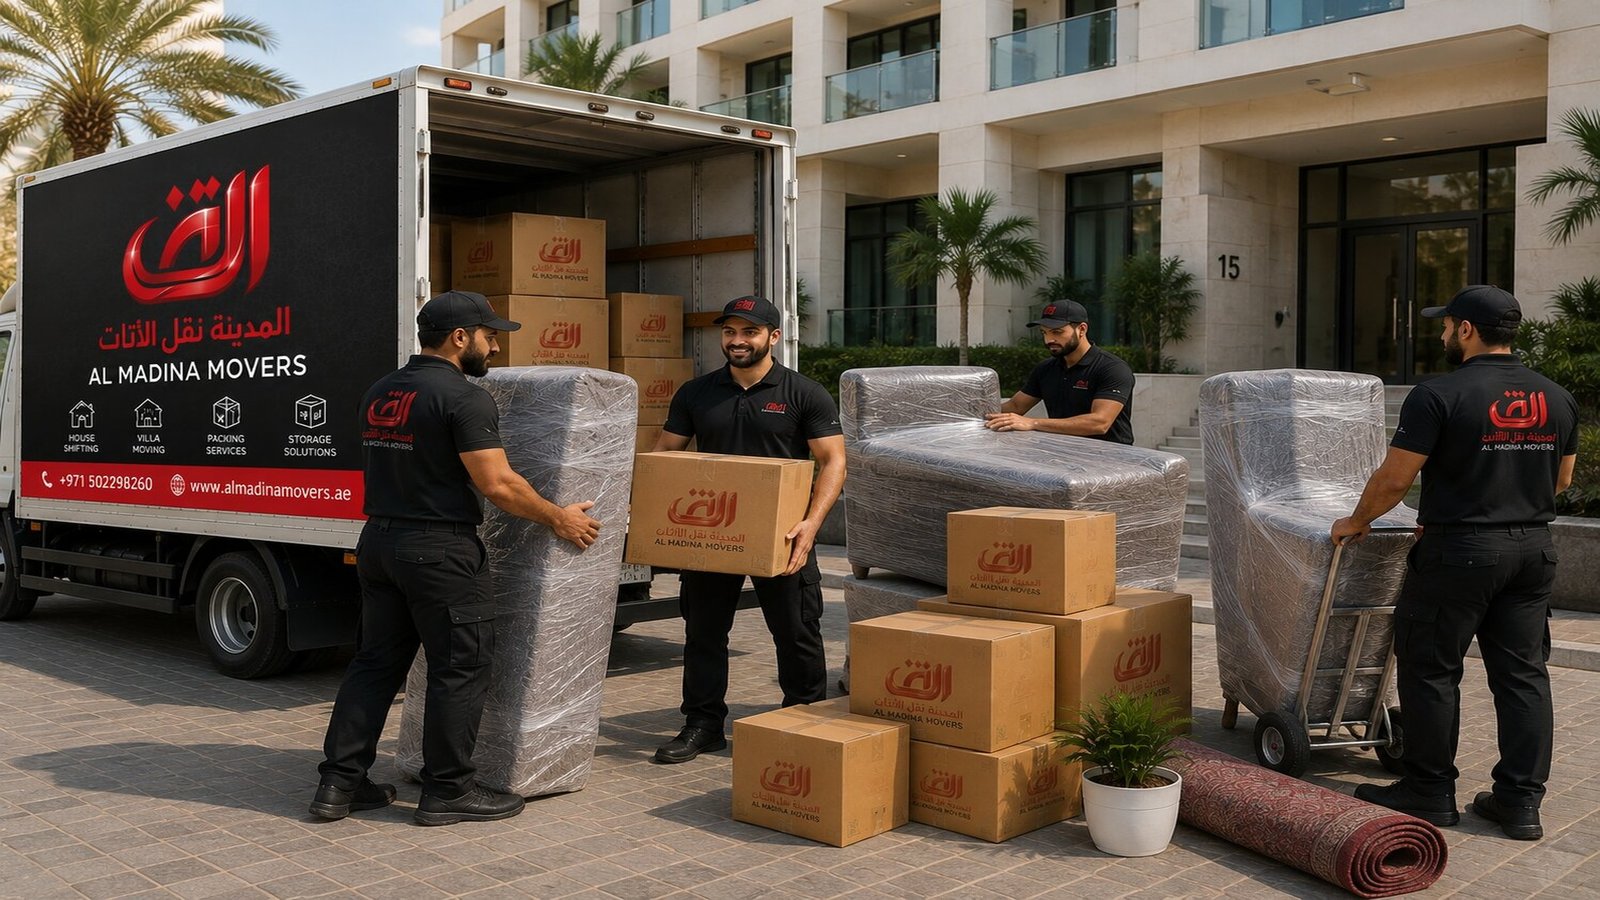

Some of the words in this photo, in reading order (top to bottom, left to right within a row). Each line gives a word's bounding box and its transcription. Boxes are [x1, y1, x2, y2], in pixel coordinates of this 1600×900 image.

[1218, 254, 1240, 280] 15
[210, 306, 291, 347] المدينة
[161, 317, 204, 354] نقل
[89, 367, 113, 386] AL
[118, 361, 201, 385] MADINA
[208, 354, 307, 381] MOVERS
[68, 434, 96, 442] HOUSE
[137, 434, 160, 442] VILLA
[207, 434, 245, 443] PACKING
[288, 435, 332, 444] STORAGE
[63, 444, 99, 453] SHIFTING
[132, 446, 165, 454] MOVING
[206, 446, 247, 455] SERVICES
[283, 447, 337, 457] SOLUTIONS
[60, 474, 85, 488] +971
[88, 475, 153, 491] 502298260
[190, 480, 352, 501] www.almadinamovers.ae
[655, 538, 666, 546] AL
[705, 542, 744, 553] MOVERS
[873, 708, 885, 717] AL
